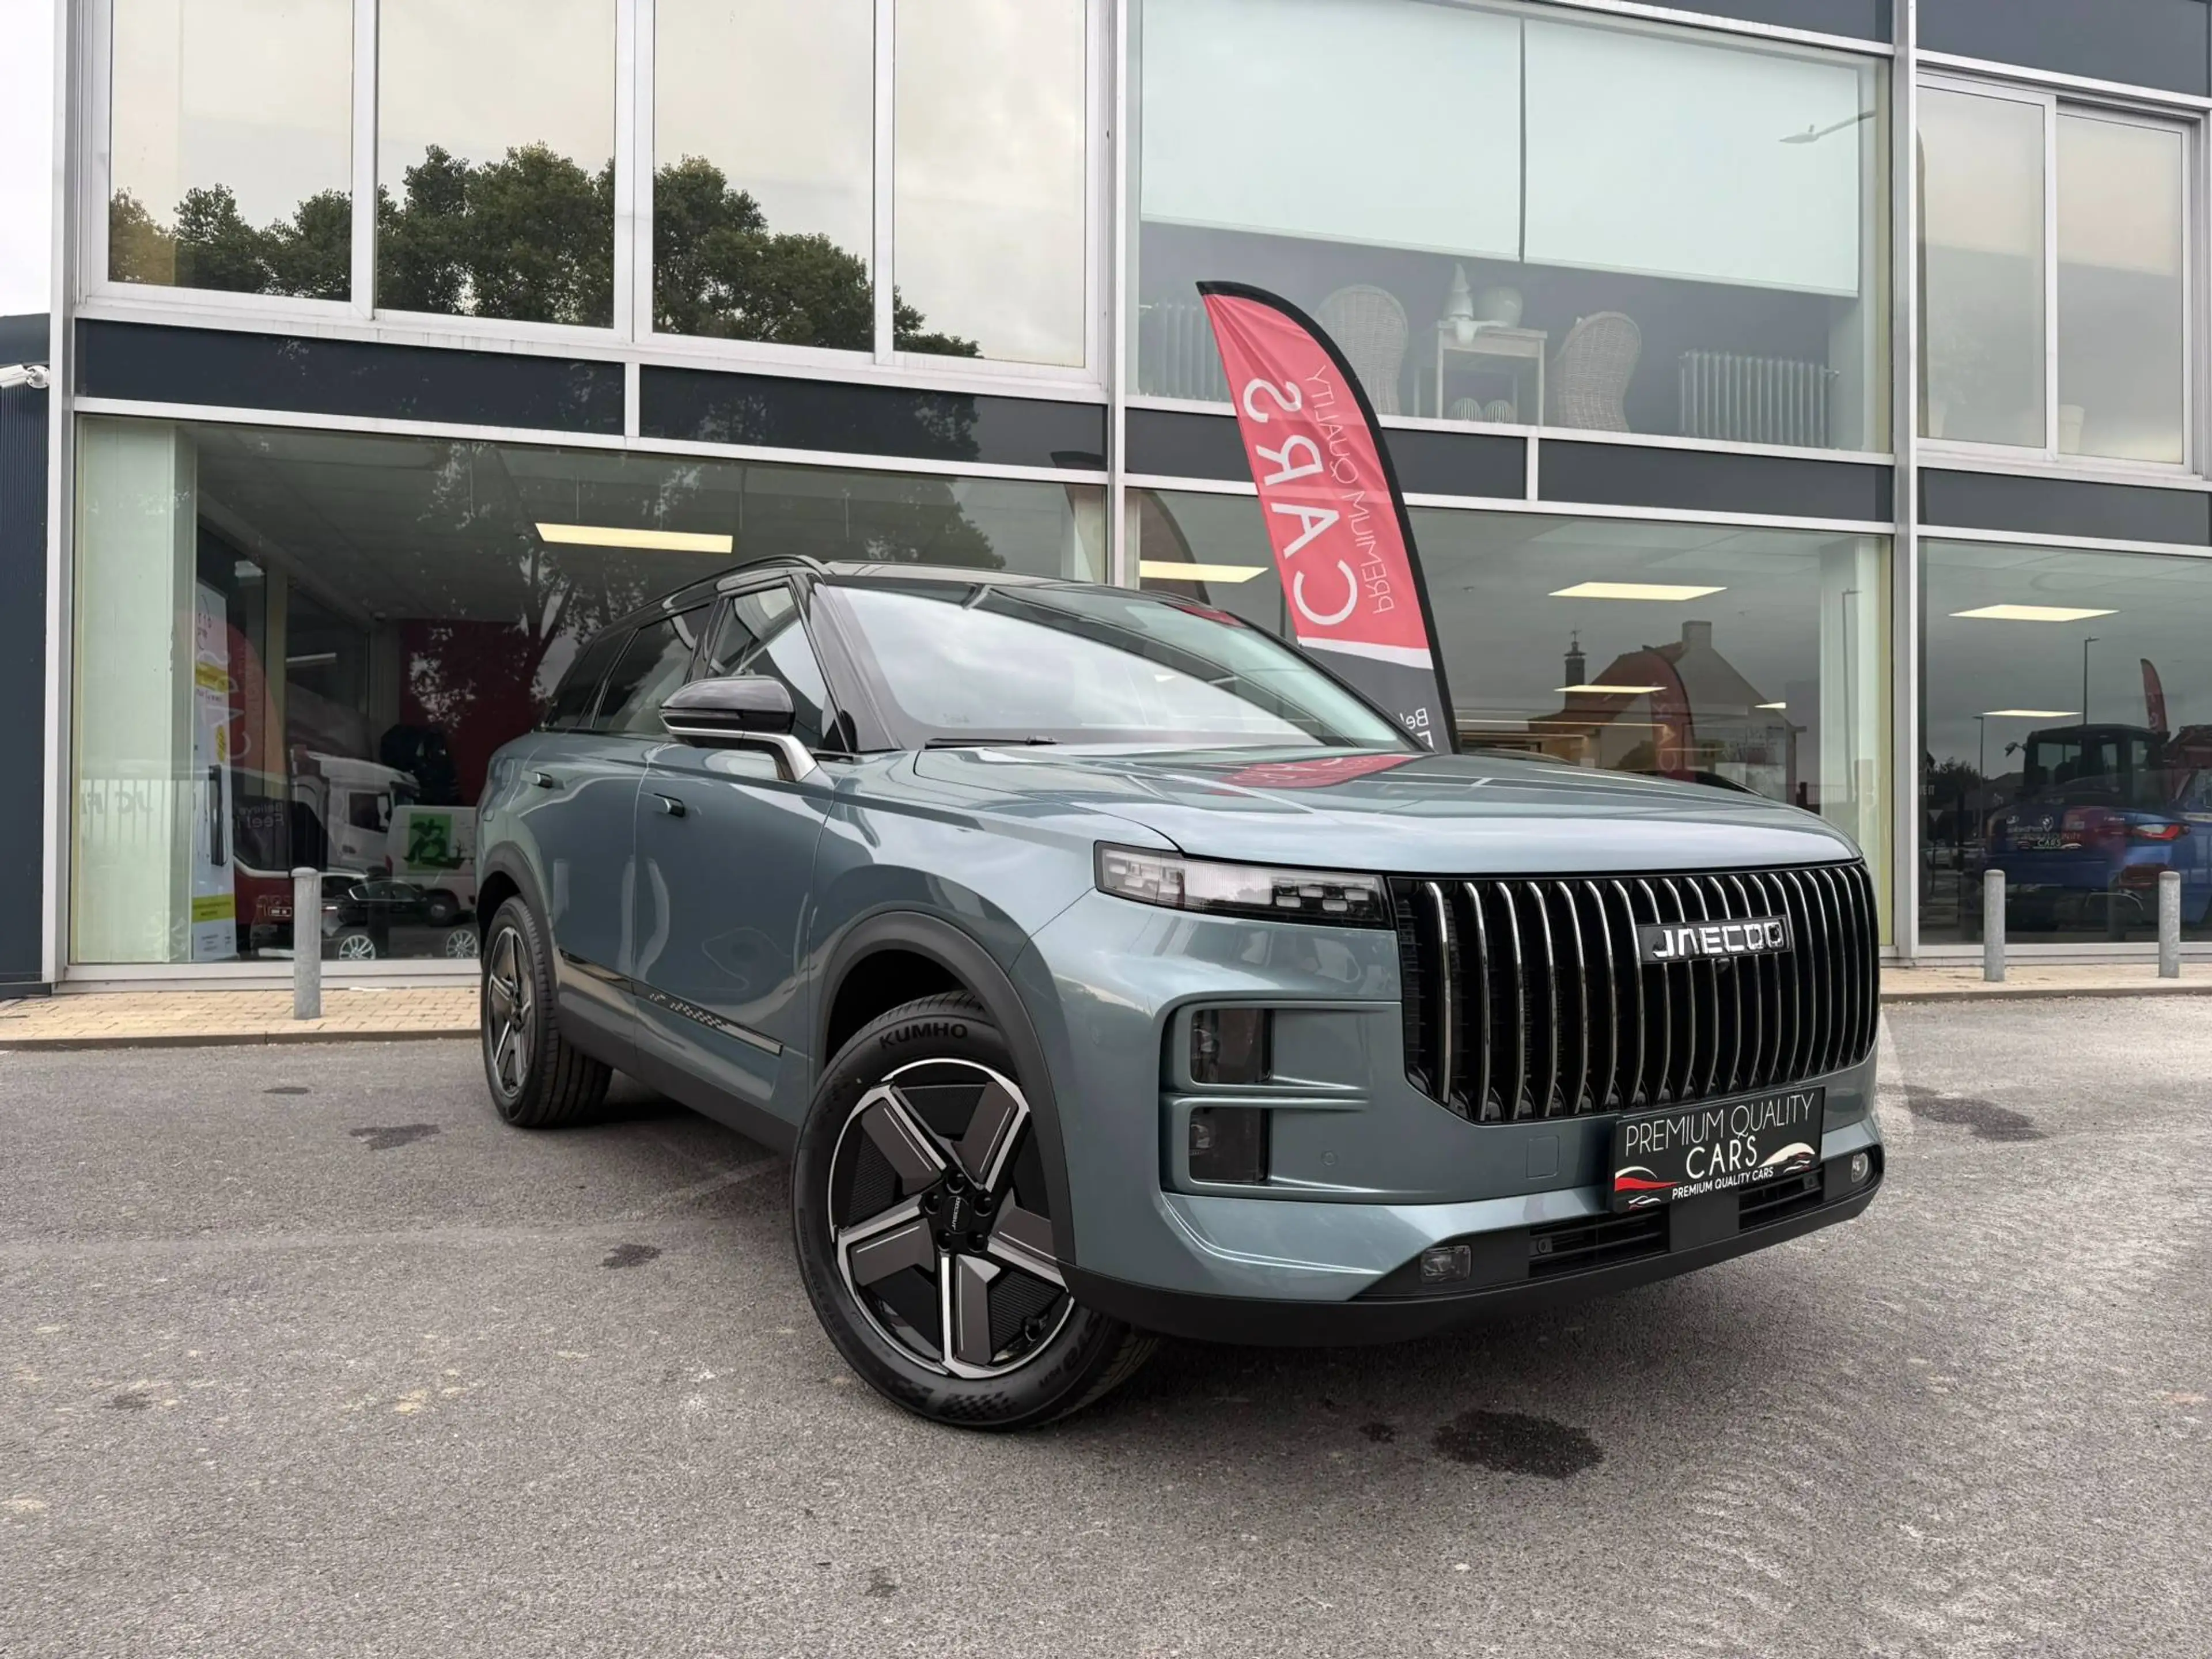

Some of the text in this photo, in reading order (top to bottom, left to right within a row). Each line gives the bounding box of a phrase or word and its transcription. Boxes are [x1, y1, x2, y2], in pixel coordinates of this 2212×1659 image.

[1653, 921, 1783, 957] JAECOO
[880, 1022, 968, 1049] KUMHO
[1626, 1093, 1815, 1157] PREMIUM QUALITY
[1685, 1136, 1758, 1180] CARS
[1672, 1166, 1774, 1199] PREMIUM QUALITY CARS
